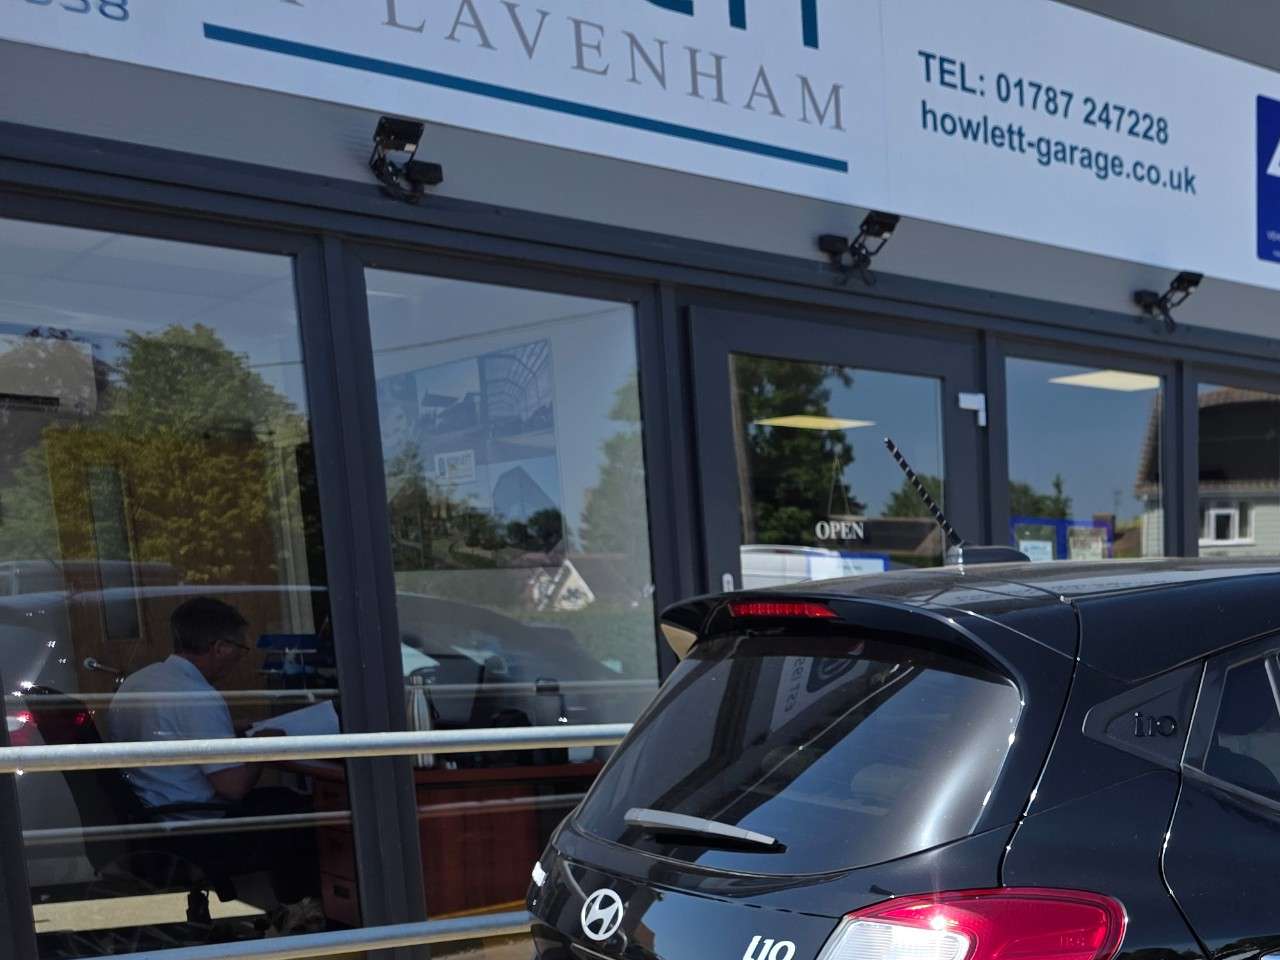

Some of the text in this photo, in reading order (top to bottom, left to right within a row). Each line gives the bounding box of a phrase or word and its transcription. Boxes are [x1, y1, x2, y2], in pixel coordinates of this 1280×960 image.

[381, 0, 847, 132] LAVENHAM
[918, 50, 1168, 145] TEL: 01787 247228
[921, 99, 1197, 195] howlett-garage.co.uk
[815, 520, 864, 540] OPEN
